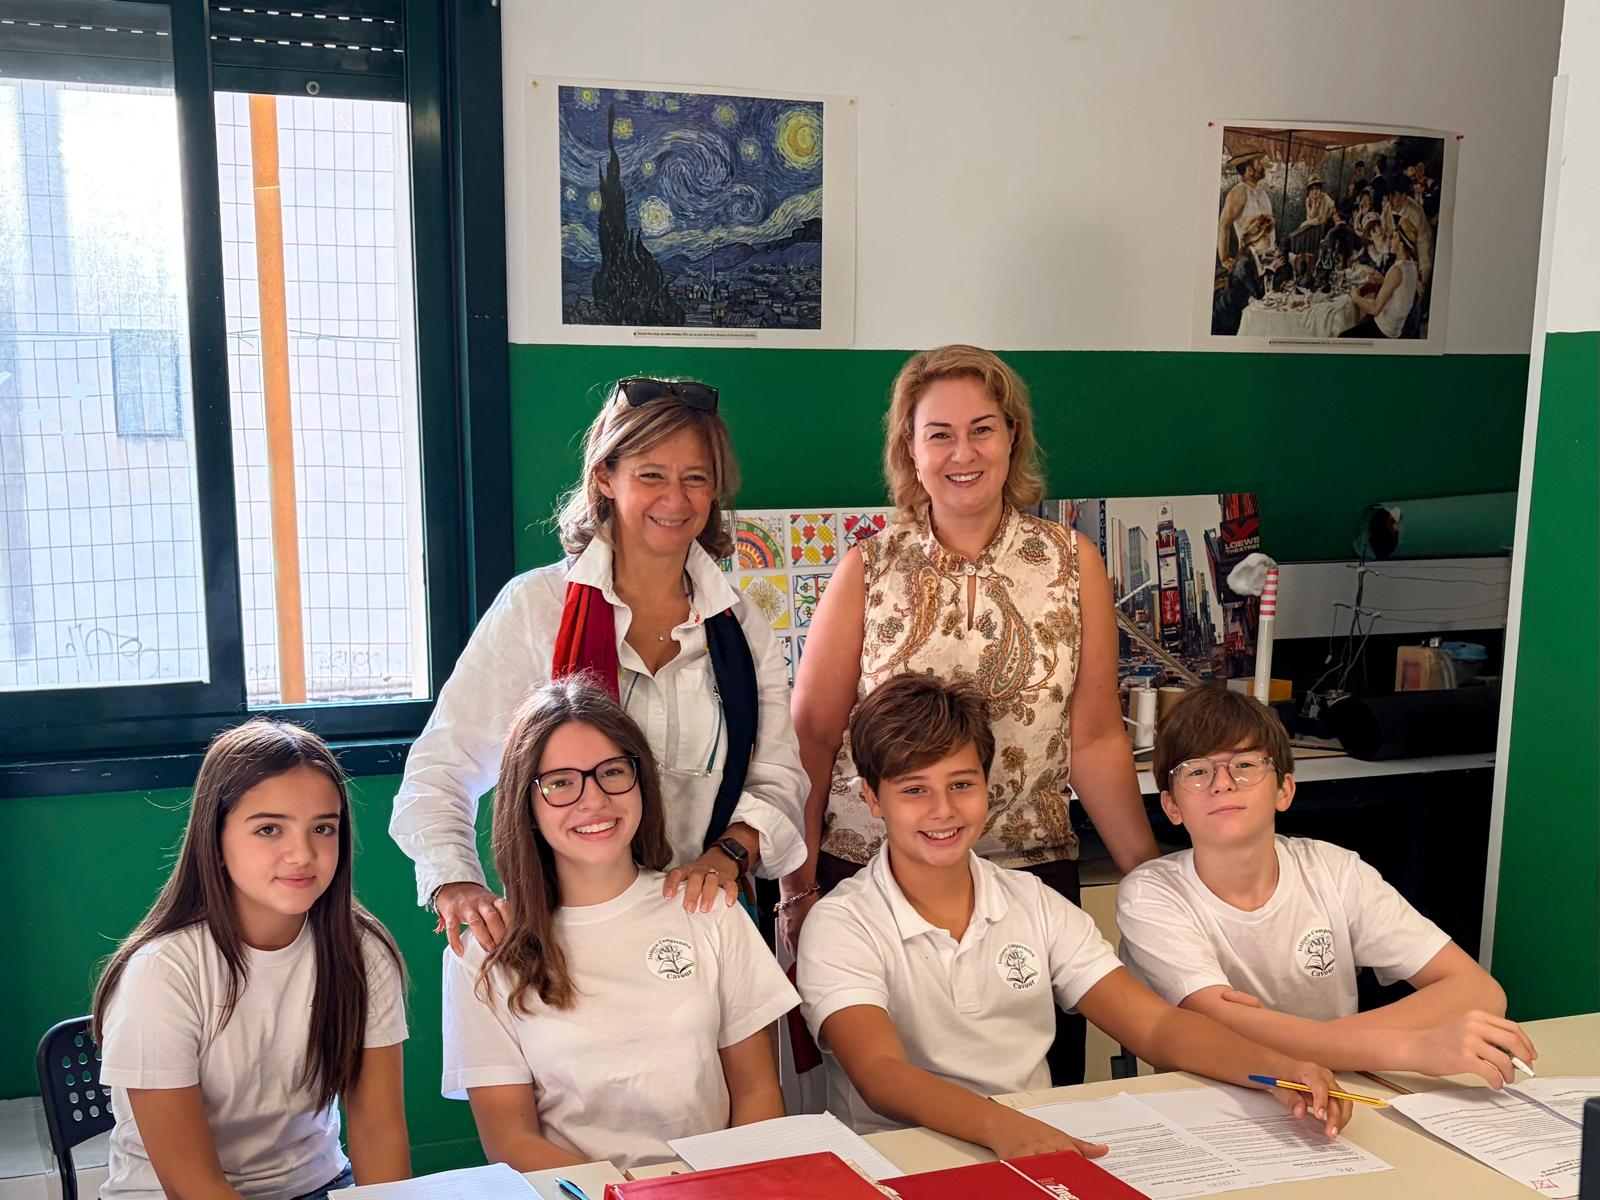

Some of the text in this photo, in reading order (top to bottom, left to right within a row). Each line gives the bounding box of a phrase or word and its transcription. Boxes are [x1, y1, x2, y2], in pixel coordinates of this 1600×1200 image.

[666, 970, 692, 980] Cavour
[1311, 966, 1334, 977] Cavour
[1013, 980, 1036, 990] Cavour
